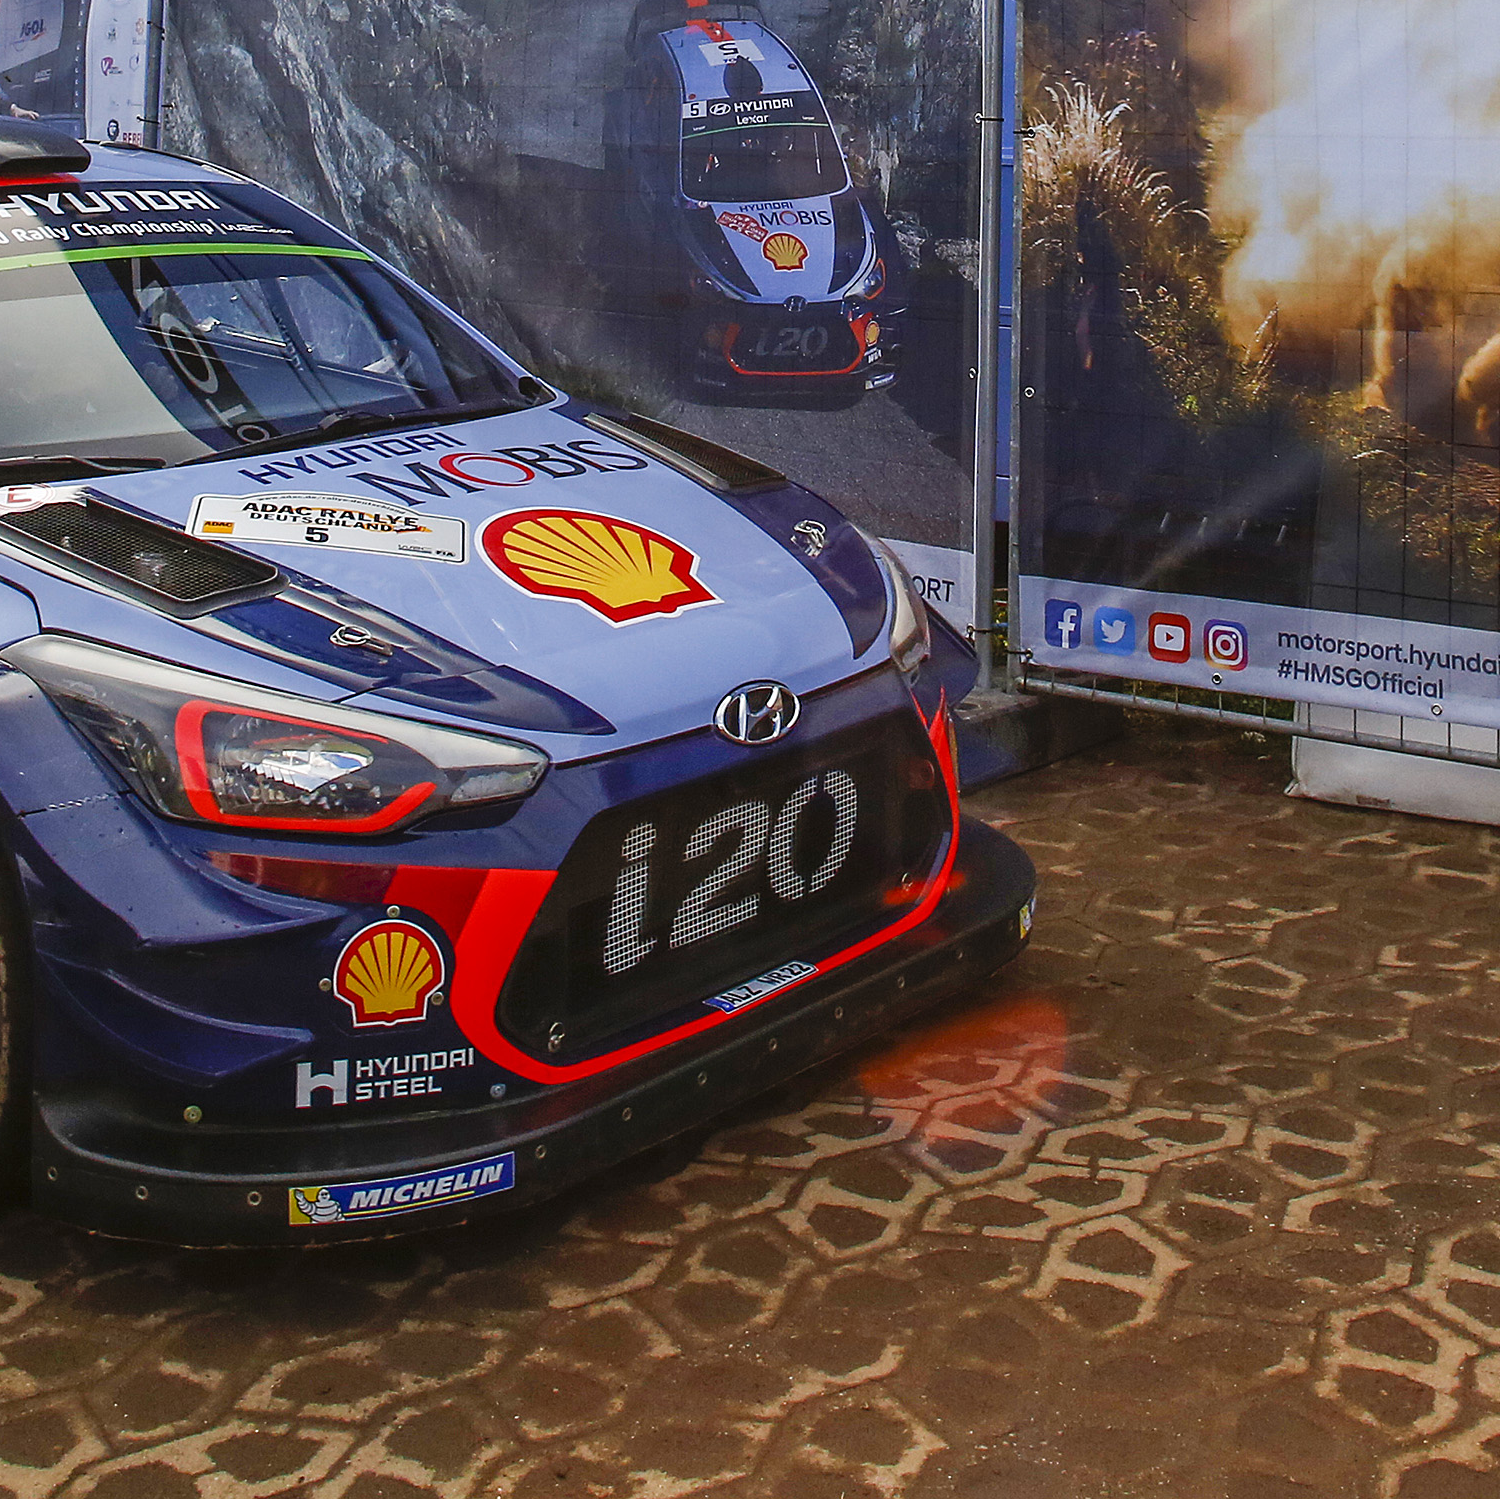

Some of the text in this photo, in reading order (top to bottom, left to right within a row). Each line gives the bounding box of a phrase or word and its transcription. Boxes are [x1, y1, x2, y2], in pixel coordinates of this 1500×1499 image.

[690, 97, 794, 116] 5 HYUNDAI
[736, 114, 770, 125] Lexar
[739, 201, 794, 213] HYUNDAI
[758, 210, 832, 227] MOBIS
[10, 224, 71, 243] Rally
[71, 219, 217, 238] Championship
[236, 431, 468, 485] HYUNDAI
[346, 440, 649, 507] MOBIS
[203, 519, 233, 529] ADAC
[241, 502, 420, 528] ADAC RALLYE
[249, 511, 394, 533] DEUTSCHLAND
[304, 526, 330, 544] 5
[1276, 658, 1444, 700] #HMSGOfficial
[602, 768, 859, 977] i20
[720, 984, 763, 1006] ALZ
[354, 1046, 476, 1079] HYUNDAI
[354, 1074, 443, 1102] STEEL
[347, 1162, 505, 1211] MICHELIN
